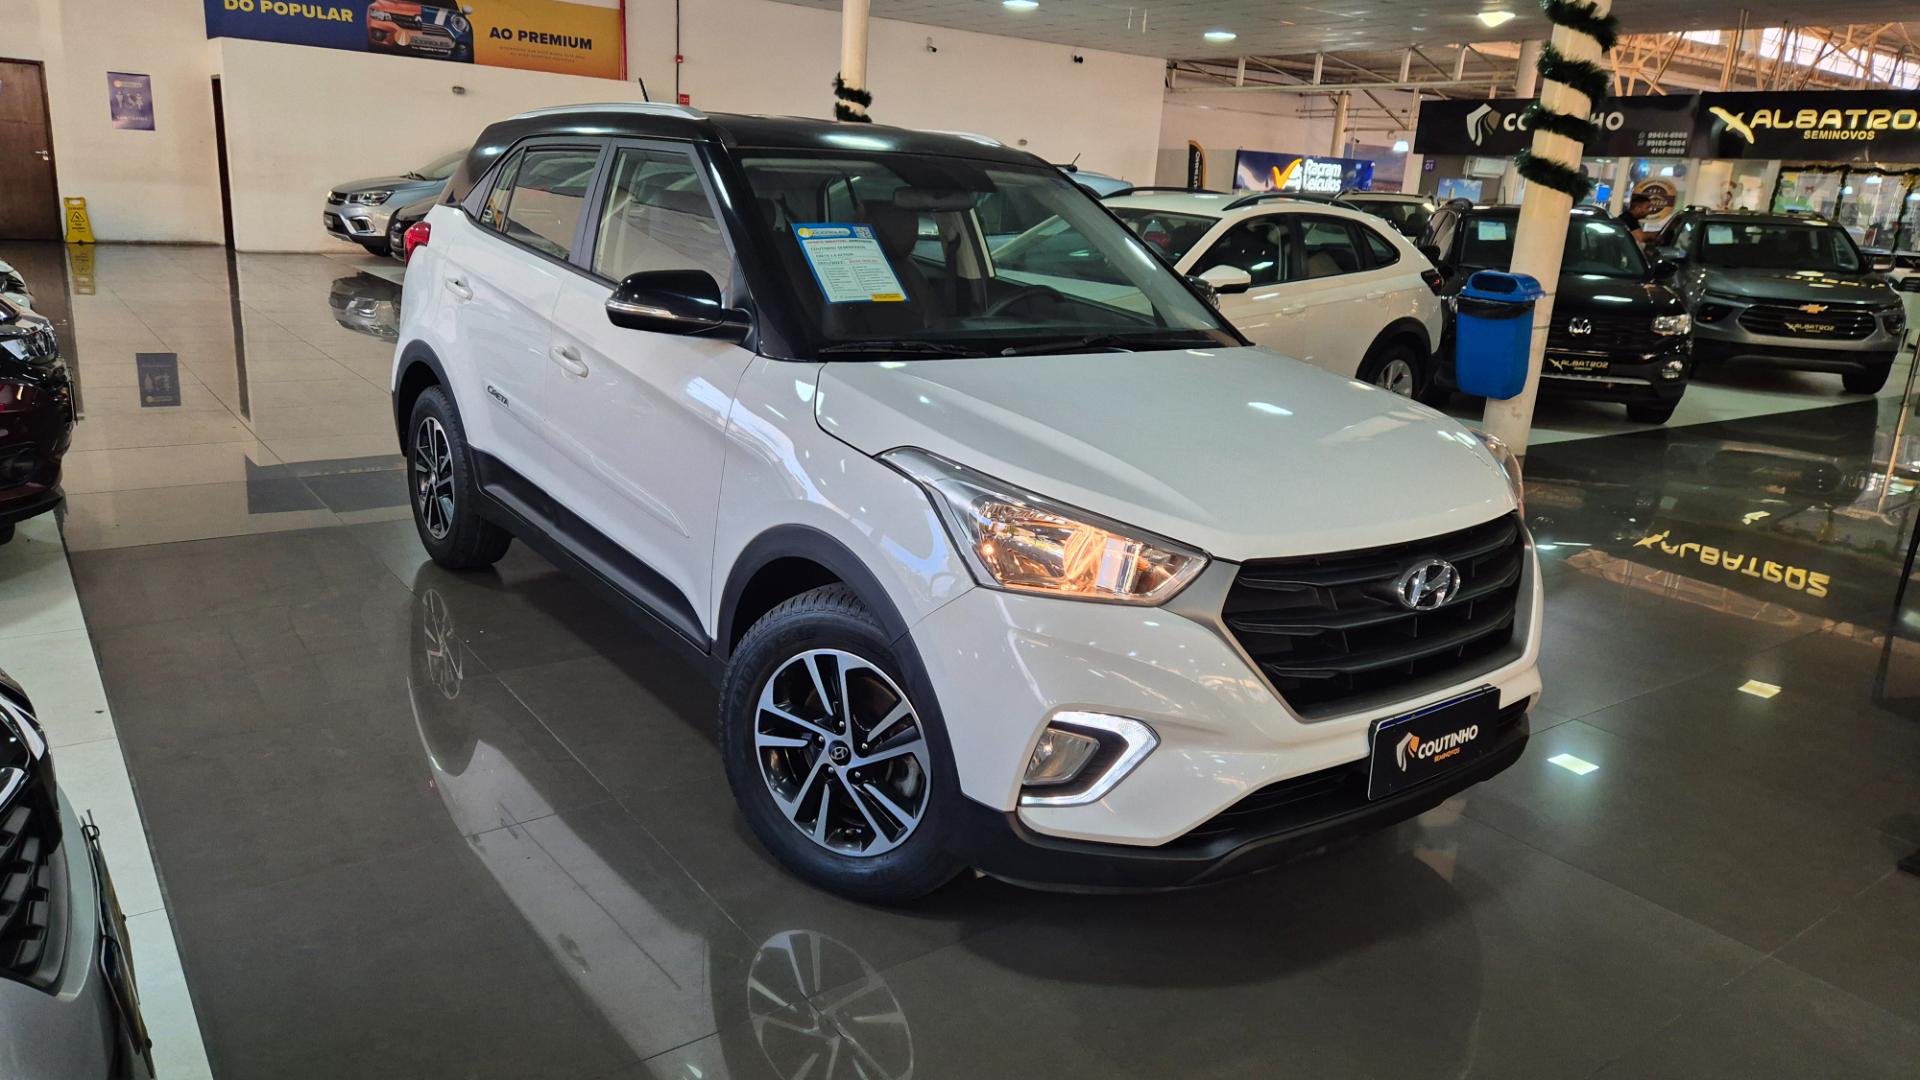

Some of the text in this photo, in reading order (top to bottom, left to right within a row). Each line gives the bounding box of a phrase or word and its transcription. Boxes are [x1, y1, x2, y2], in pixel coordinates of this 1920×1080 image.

[224, 0, 354, 23] DO POPULAR
[489, 26, 592, 51] AO PREMIUM
[1750, 108, 1920, 130] ALBATRO
[1803, 129, 1876, 141] SEMINOVOS
[1304, 158, 1342, 177] Racram
[1418, 724, 1479, 760] COUTINHO
